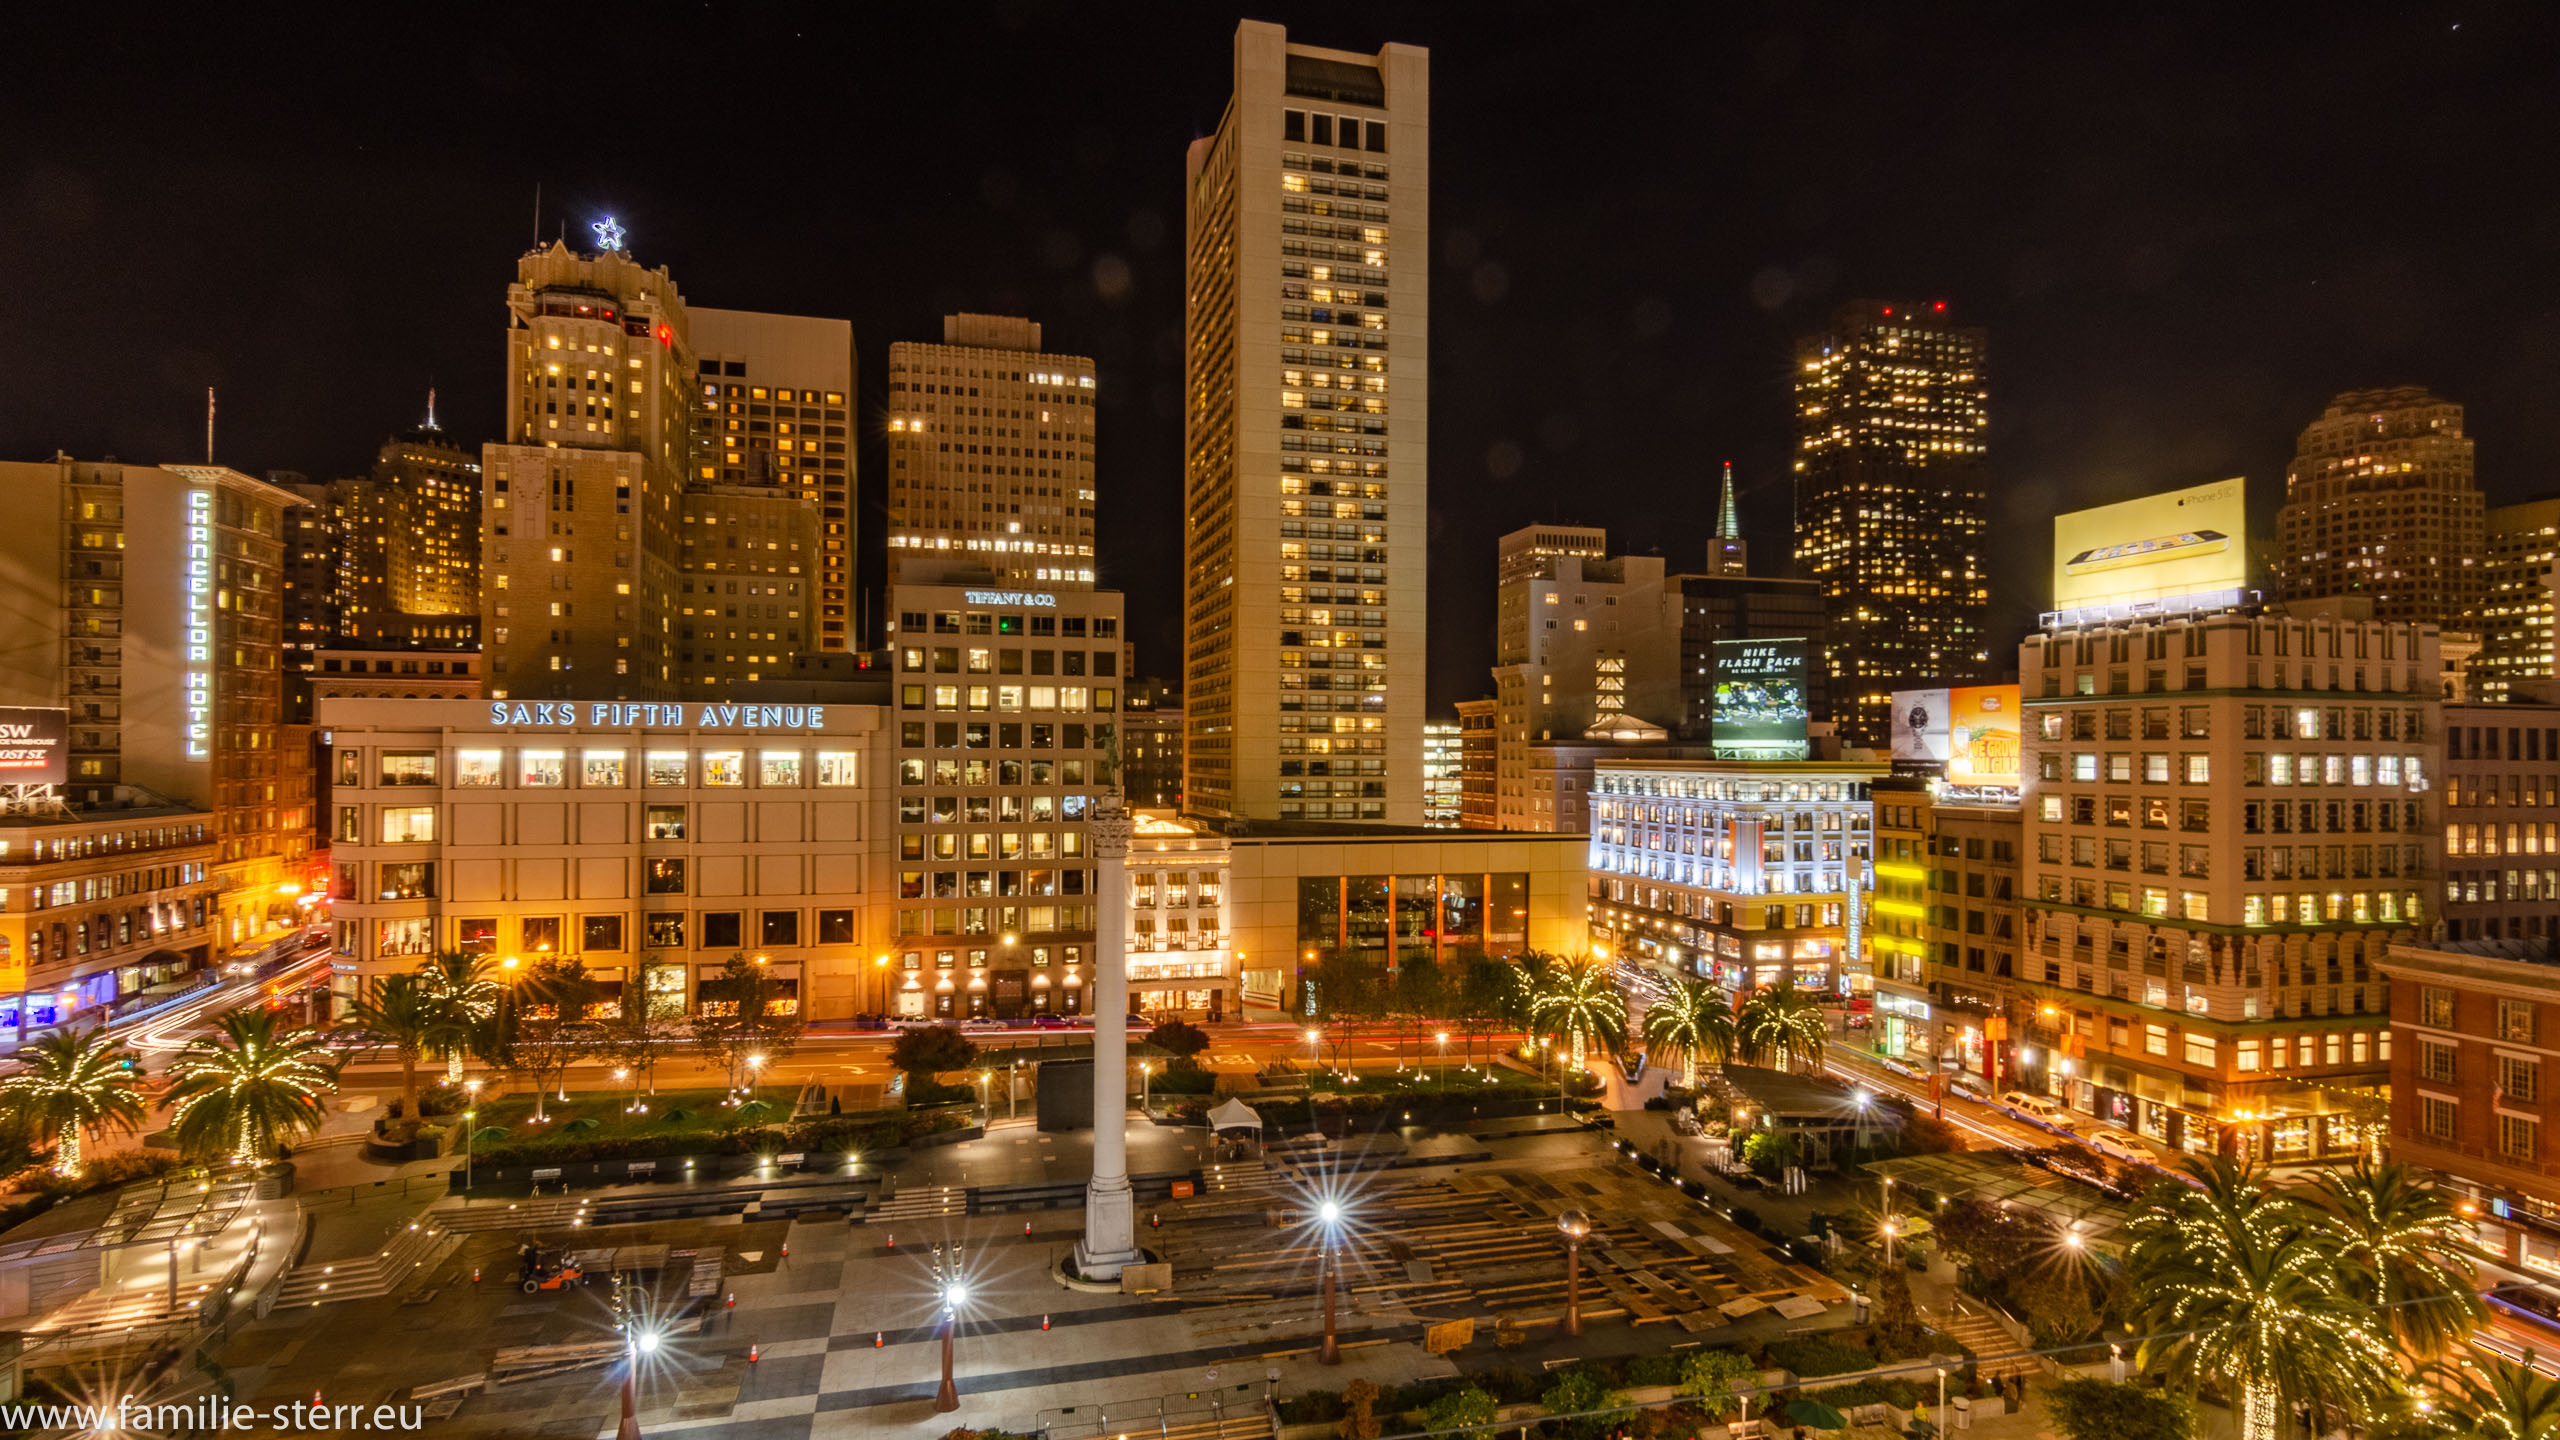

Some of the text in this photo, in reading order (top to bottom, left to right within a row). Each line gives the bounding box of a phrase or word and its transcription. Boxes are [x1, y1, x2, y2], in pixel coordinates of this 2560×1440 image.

[965, 590, 1057, 608] TIFFANY & CO.
[188, 491, 209, 756] CHANCELLOR HOTEL
[1742, 647, 1777, 657] NIKE
[1718, 656, 1802, 669] FLASH PACK
[491, 702, 825, 728] SAKS FIFTH AVENUE
[0, 749, 27, 760] OST
[1968, 739, 2020, 758] WE GROW
[1991, 757, 2020, 775] GULP
